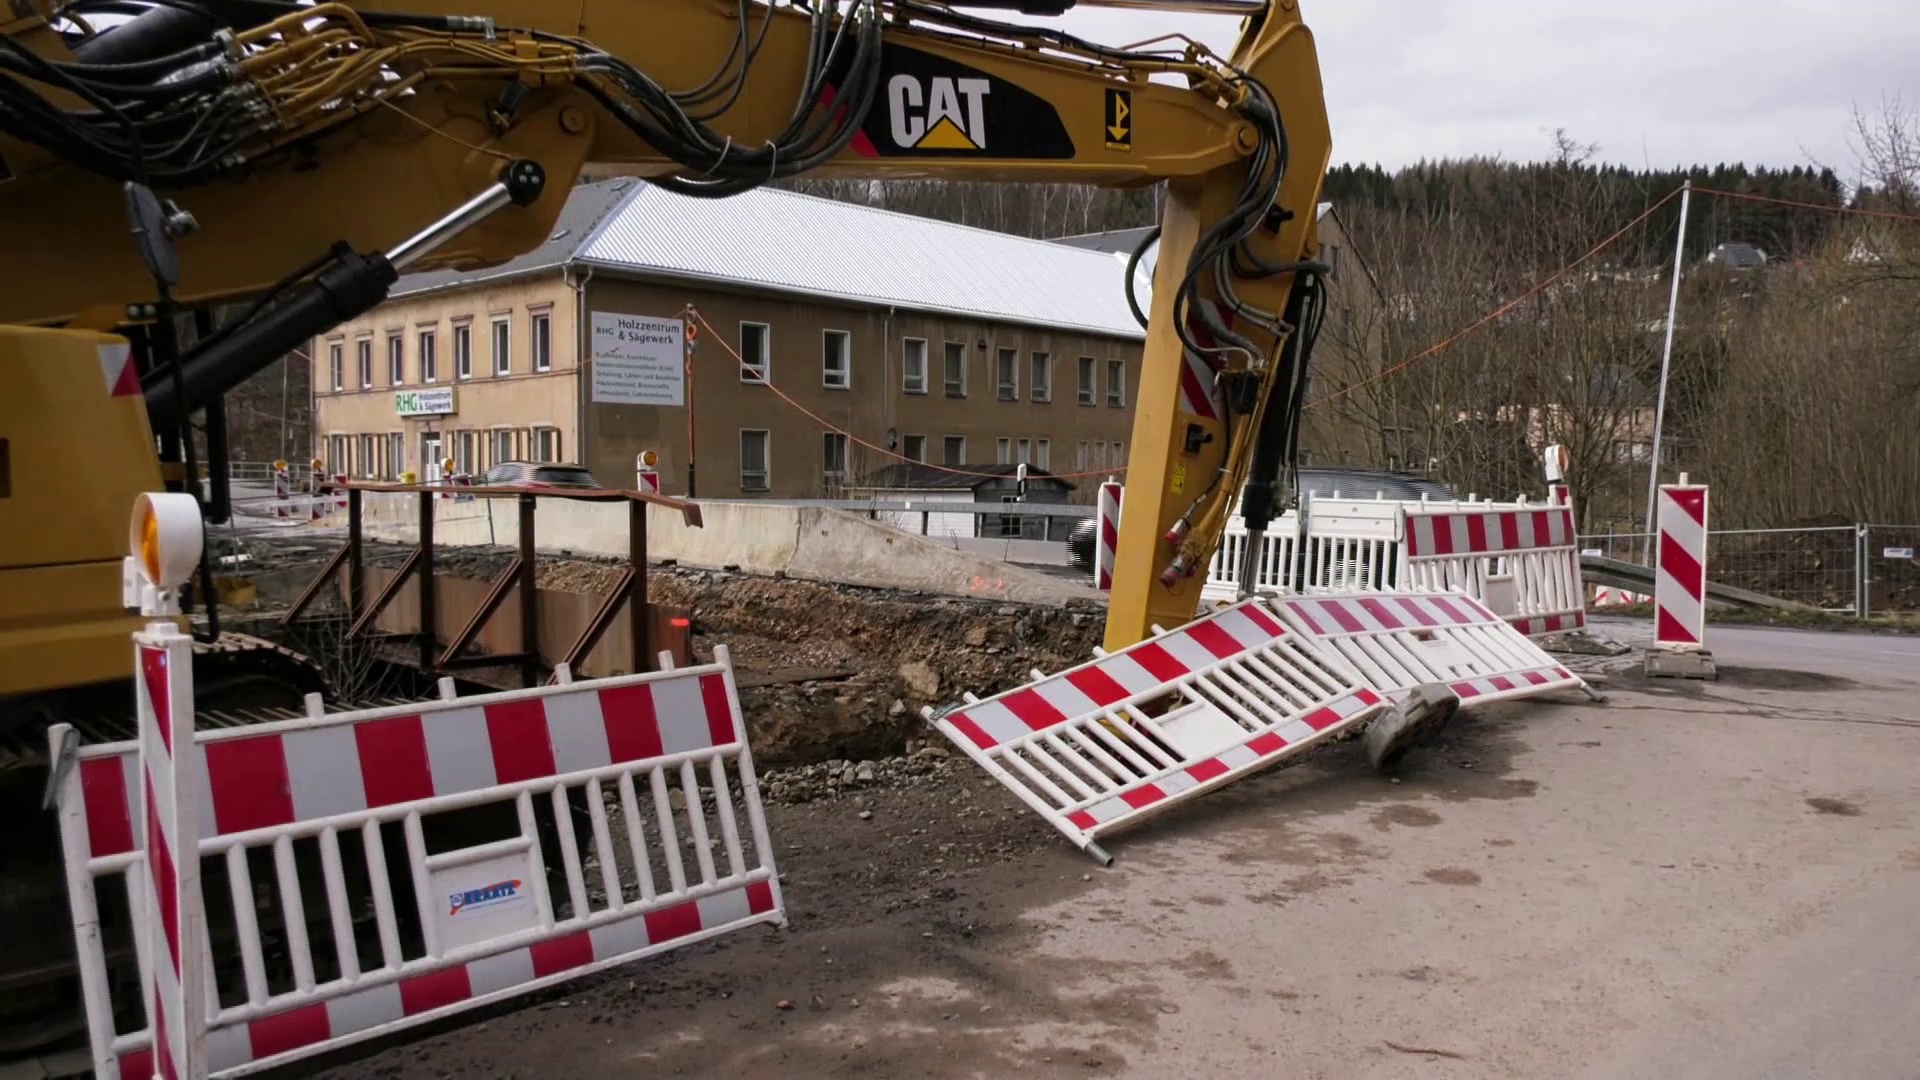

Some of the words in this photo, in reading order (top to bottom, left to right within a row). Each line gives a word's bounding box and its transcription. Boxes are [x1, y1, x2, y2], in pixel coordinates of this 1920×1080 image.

[888, 74, 990, 149] CAT
[596, 327, 614, 335] RHG
[618, 319, 680, 333] Holzzentrum
[618, 331, 625, 340] &
[629, 331, 674, 344] Sägewerk
[396, 393, 418, 411] RHG
